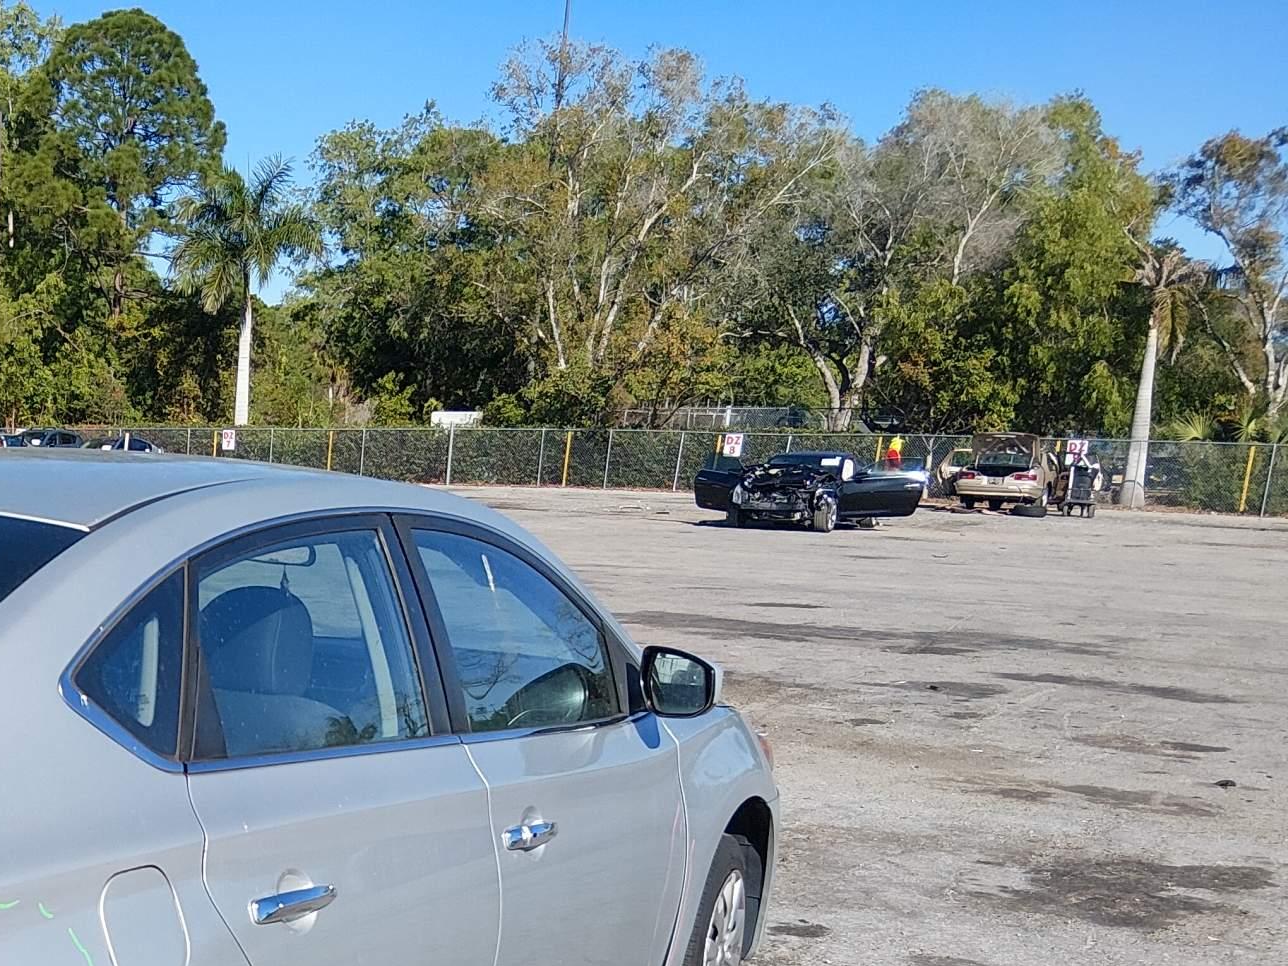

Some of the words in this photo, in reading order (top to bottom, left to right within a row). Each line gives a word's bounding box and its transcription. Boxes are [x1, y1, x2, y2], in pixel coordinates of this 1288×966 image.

[726, 436, 742, 445] DZ
[729, 446, 735, 455] 8
[1069, 442, 1086, 452] DZ
